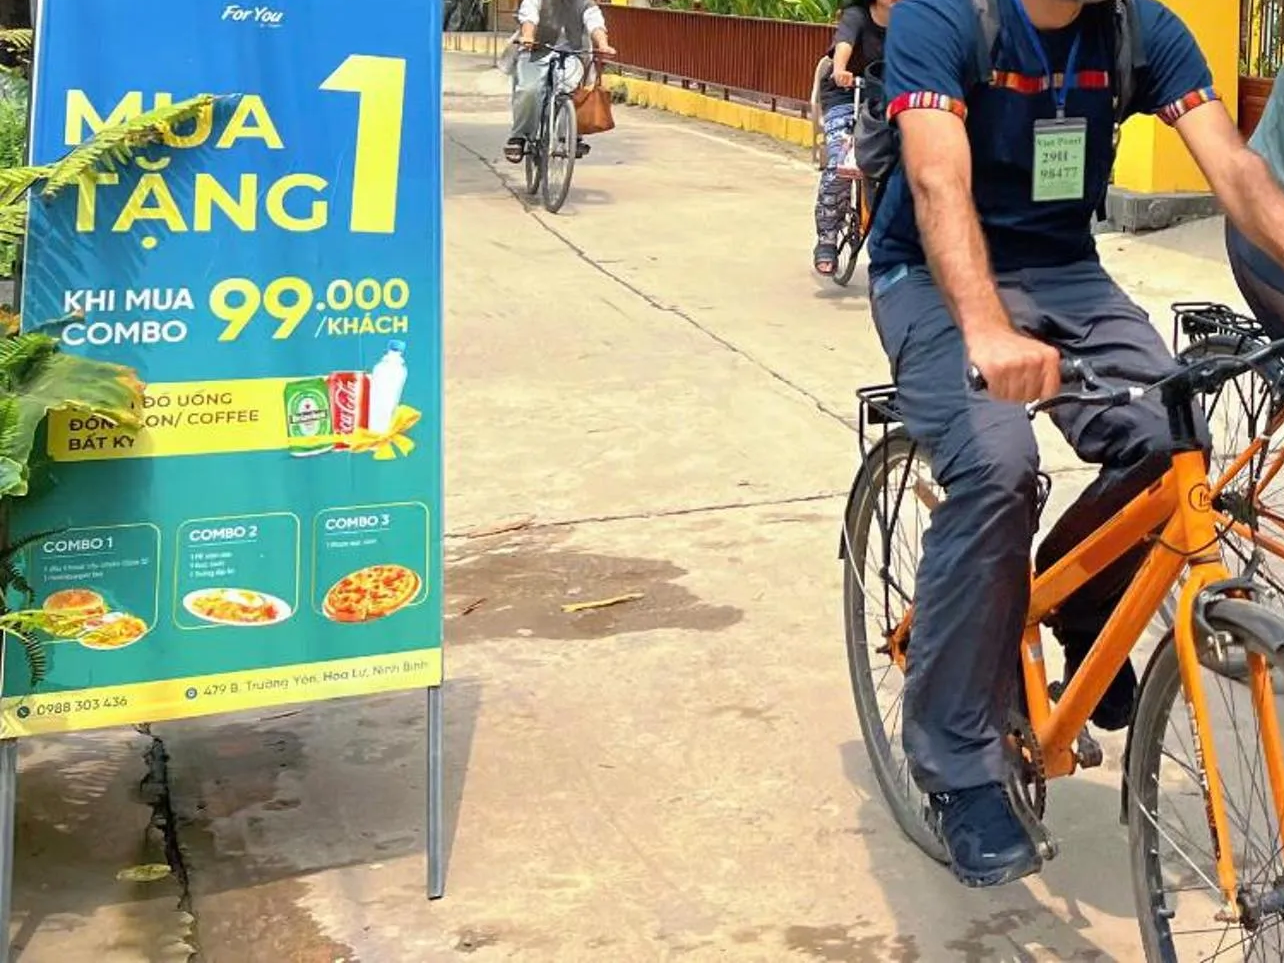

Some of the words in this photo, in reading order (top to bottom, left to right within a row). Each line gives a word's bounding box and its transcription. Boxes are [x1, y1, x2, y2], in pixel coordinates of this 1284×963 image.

[222, 4, 252, 21] For
[254, 6, 283, 23] You
[319, 54, 406, 234] 1
[64, 289, 116, 313] KHI
[126, 287, 195, 312] MUA
[62, 320, 188, 347] COMBO
[187, 409, 260, 425] COFFEE
[325, 515, 379, 530] COMBO
[381, 514, 390, 526] 3
[189, 525, 246, 541] COMBO
[248, 525, 258, 538] 2
[43, 537, 104, 553] COMBO
[106, 536, 114, 548] 1
[37, 701, 71, 716] 0988
[75, 698, 100, 712] 303
[103, 696, 128, 708] 436
